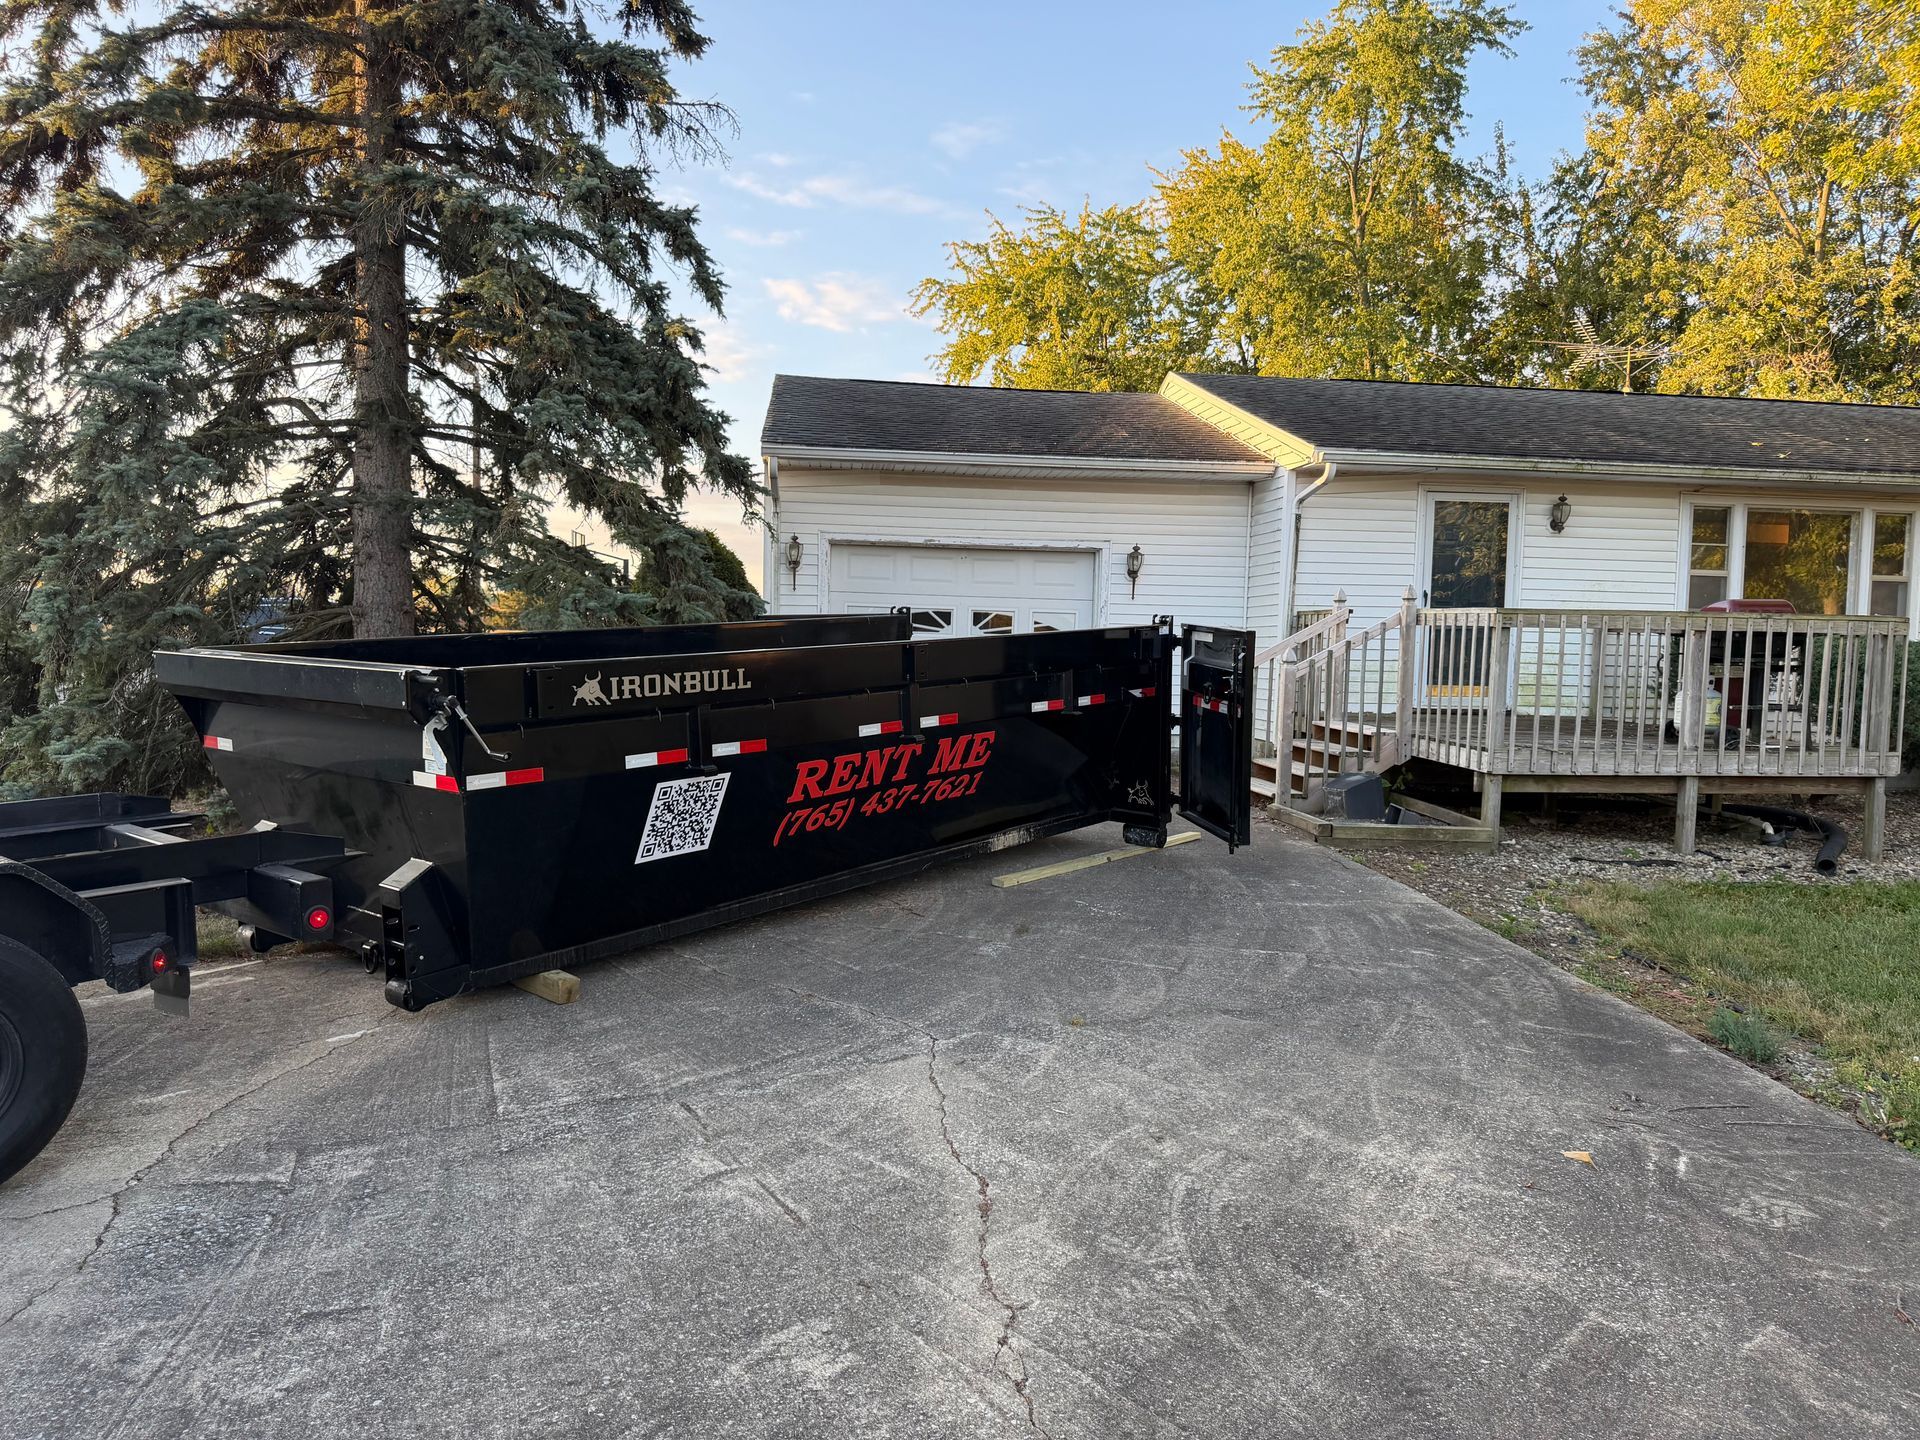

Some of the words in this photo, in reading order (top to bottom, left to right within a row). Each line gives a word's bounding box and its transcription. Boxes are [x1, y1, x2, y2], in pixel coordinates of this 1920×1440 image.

[609, 668, 752, 700] IRONBULL
[787, 743, 922, 803] RENT
[927, 731, 995, 775] ME
[773, 798, 855, 847] (765)
[860, 771, 983, 817] 437-7621
